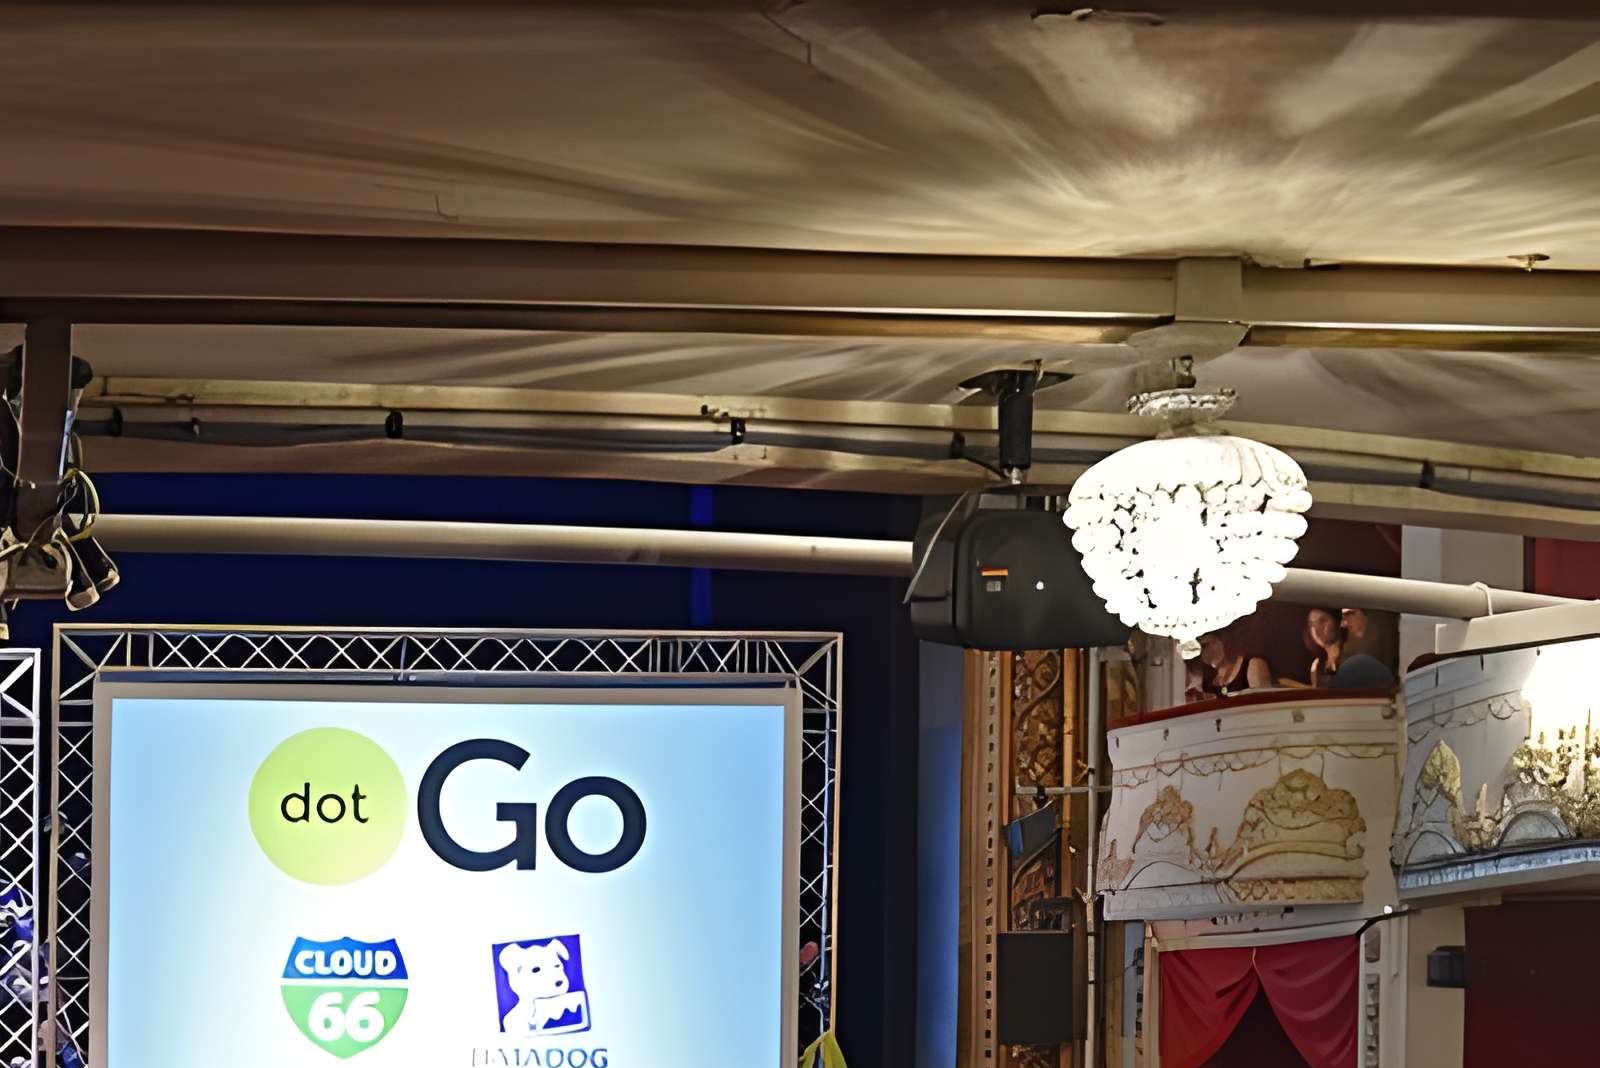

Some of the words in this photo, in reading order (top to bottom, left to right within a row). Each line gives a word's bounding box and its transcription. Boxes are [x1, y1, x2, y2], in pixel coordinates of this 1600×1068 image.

[280, 782, 369, 824] dot
[417, 738, 647, 874] Go
[295, 949, 397, 976] CLOUD
[308, 991, 385, 1043] 66
